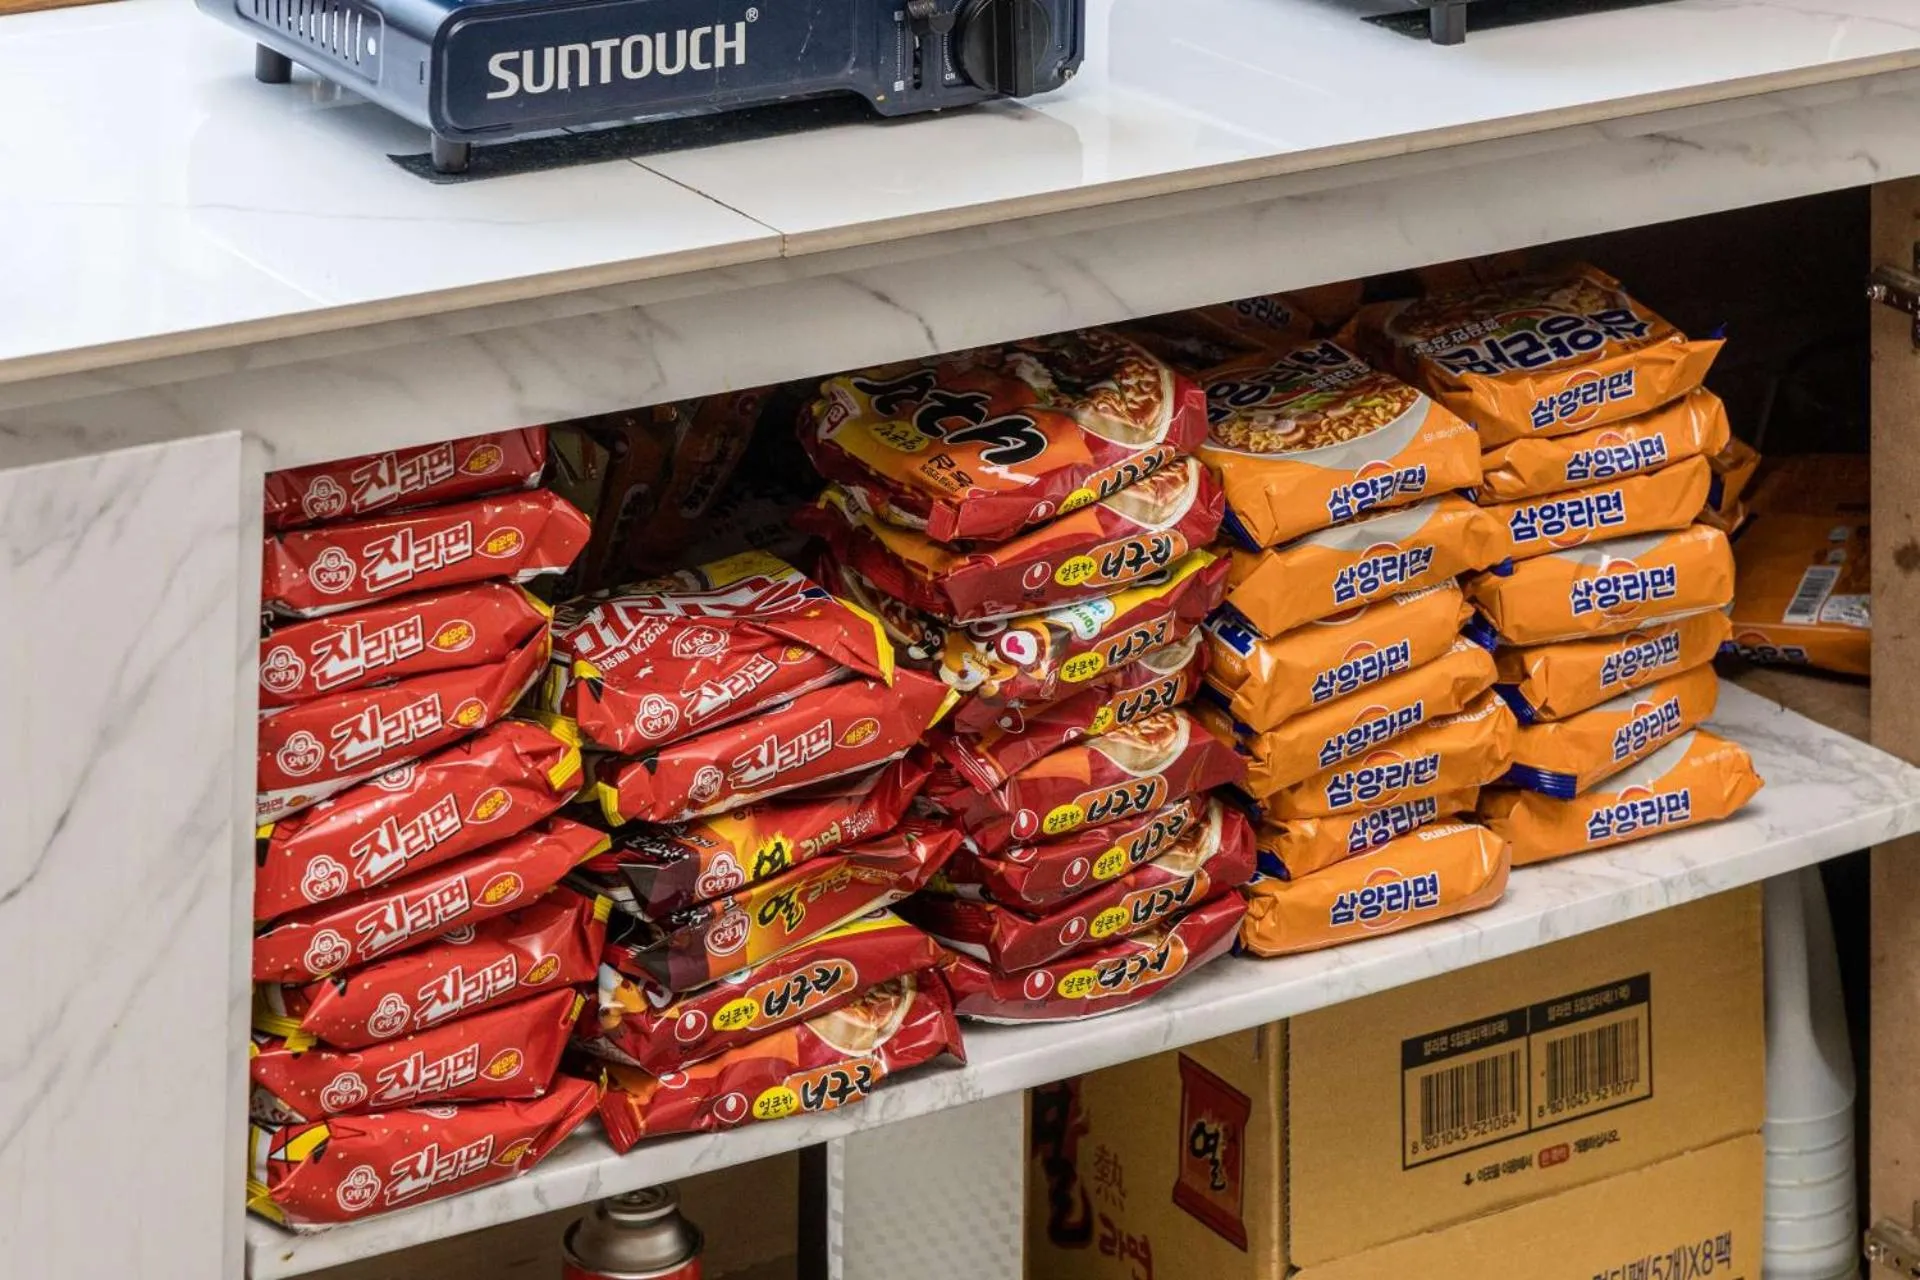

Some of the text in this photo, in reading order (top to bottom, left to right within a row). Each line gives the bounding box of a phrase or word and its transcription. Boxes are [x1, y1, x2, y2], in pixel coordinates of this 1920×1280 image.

[486, 22, 747, 101] SUNTOUCH
[1529, 367, 1637, 430] 삼양라면
[351, 440, 456, 514] 진라면
[1565, 433, 1669, 483] 삼양라면
[1326, 463, 1428, 521] 삼양라면
[1510, 490, 1625, 543] 삼양라면
[320, 520, 518, 593] 오뚜기 진라면 매운맛
[1061, 535, 1172, 581] 얼큰한 너구리
[1333, 546, 1434, 605] 삼양라면
[1569, 564, 1677, 616] 삼양라면
[269, 614, 468, 692] 오뚜기 진라면 매운맛
[1064, 659, 1100, 681] 얼큰한
[1310, 638, 1411, 704] 삼양라면
[1600, 631, 1681, 688] 삼양라면
[646, 653, 778, 732] 오뚜기 진라면
[1116, 677, 1180, 725] 너구리
[288, 754, 316, 768] 오뚜기
[331, 692, 444, 772] 진라면
[729, 718, 833, 789] 진라면
[1319, 700, 1423, 769] 삼양라면
[1613, 696, 1681, 763] 삼양라면
[1047, 781, 1155, 829] 얼큰한 너구리
[1325, 753, 1441, 810] 삼양라면
[313, 790, 507, 896] 오뚜기 진라면 매운맛
[1096, 808, 1188, 875] 얼큰한 너구리
[1347, 796, 1437, 854] 삼양라면
[1587, 789, 1690, 841] 삼양라면
[317, 875, 517, 967] 오뚜기 진라면 매운맛
[1094, 911, 1125, 935] 얼큰한
[1331, 872, 1440, 927] 삼양라면
[376, 1014, 403, 1029] 오뚜기
[414, 953, 518, 1030] 진라면
[718, 965, 843, 1027] 얼큰한 너구리
[330, 1091, 358, 1106] 오뚜기
[369, 1042, 480, 1107] 진라면
[758, 1095, 795, 1117] 얼큰한
[344, 1186, 371, 1203] 오뚜기
[385, 1133, 495, 1206] 진라면
